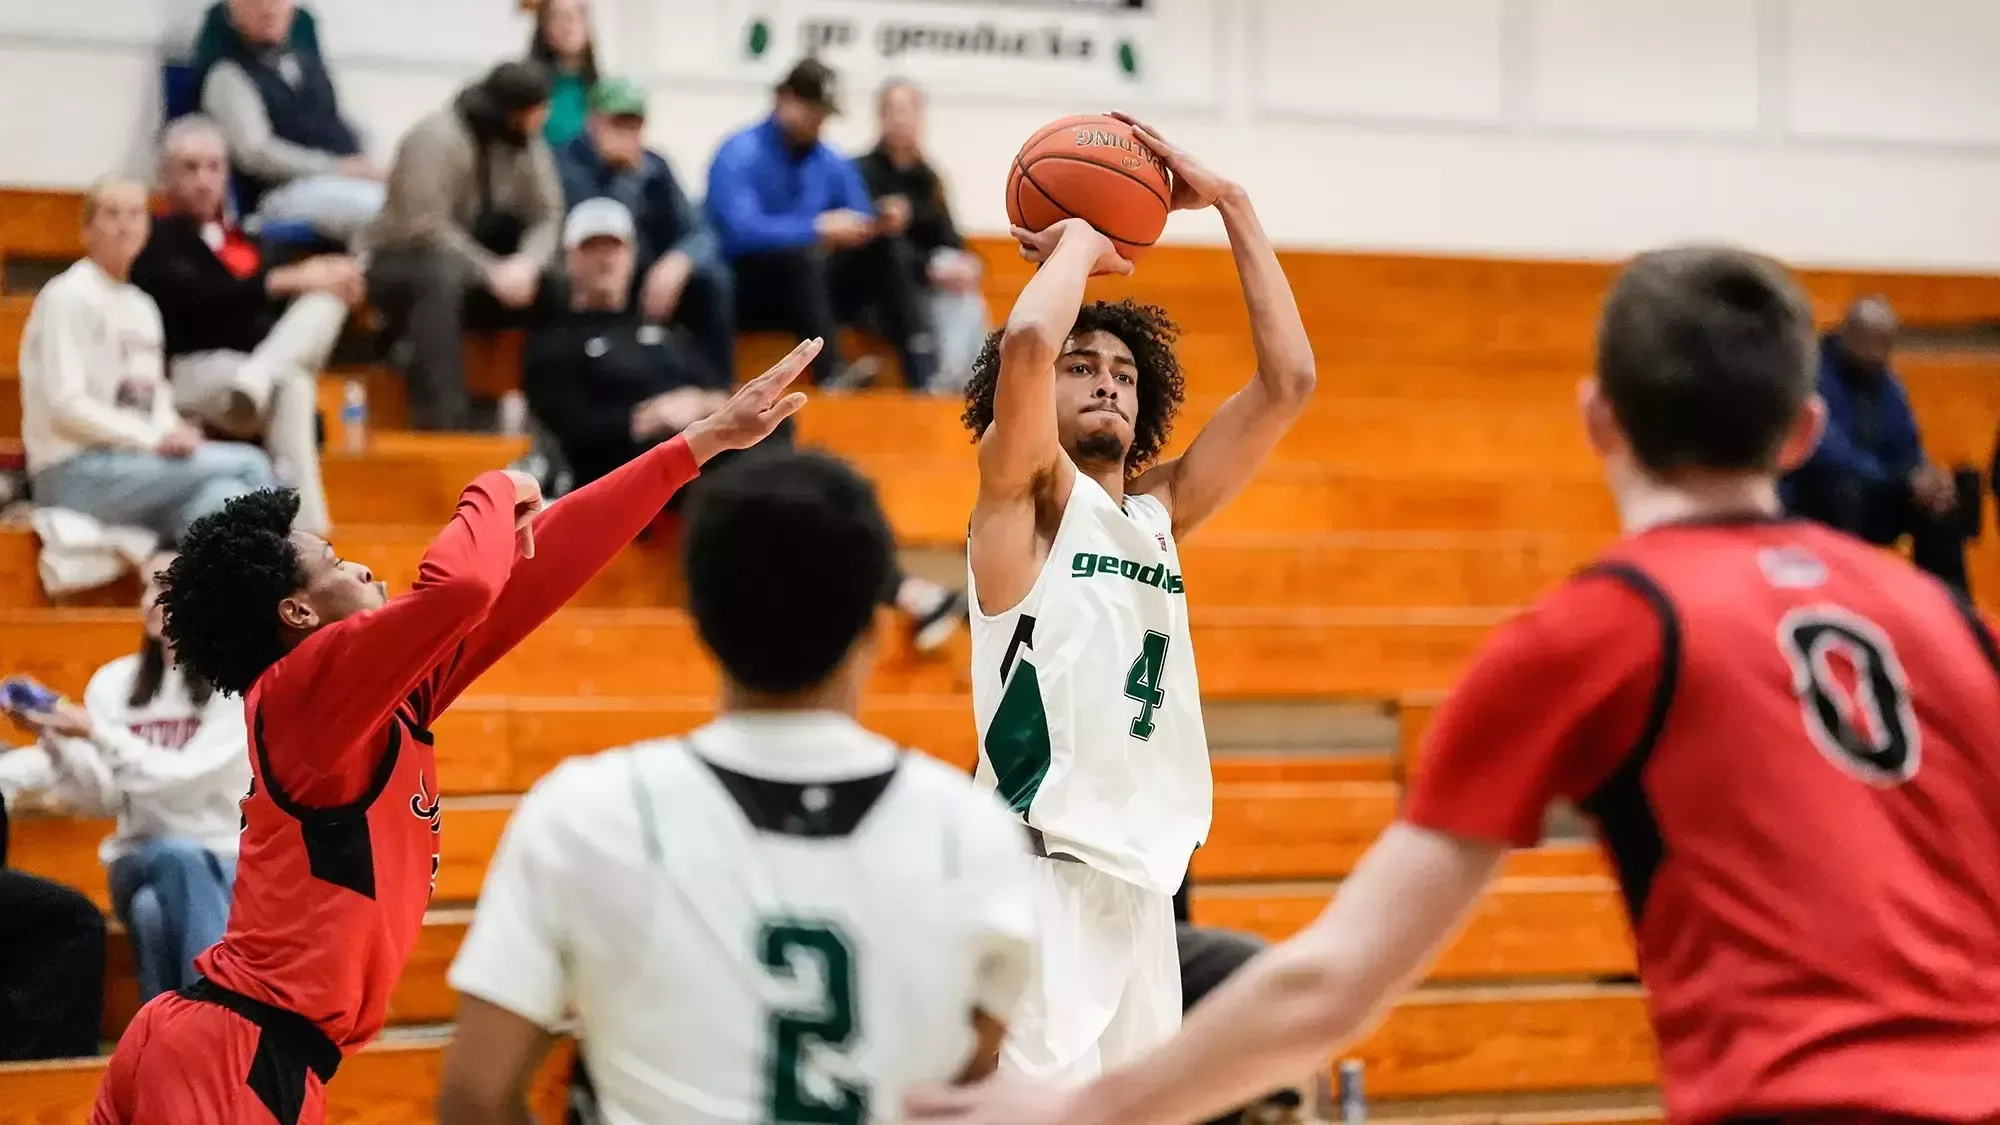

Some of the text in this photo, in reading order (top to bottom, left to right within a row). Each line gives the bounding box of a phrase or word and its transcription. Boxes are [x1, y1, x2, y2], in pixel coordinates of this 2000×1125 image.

[1075, 128, 1169, 186] PALDING
[1071, 552, 1185, 594] geods
[1123, 629, 1170, 741] 4
[1778, 603, 1920, 786] 0
[758, 918, 868, 1125] 2
